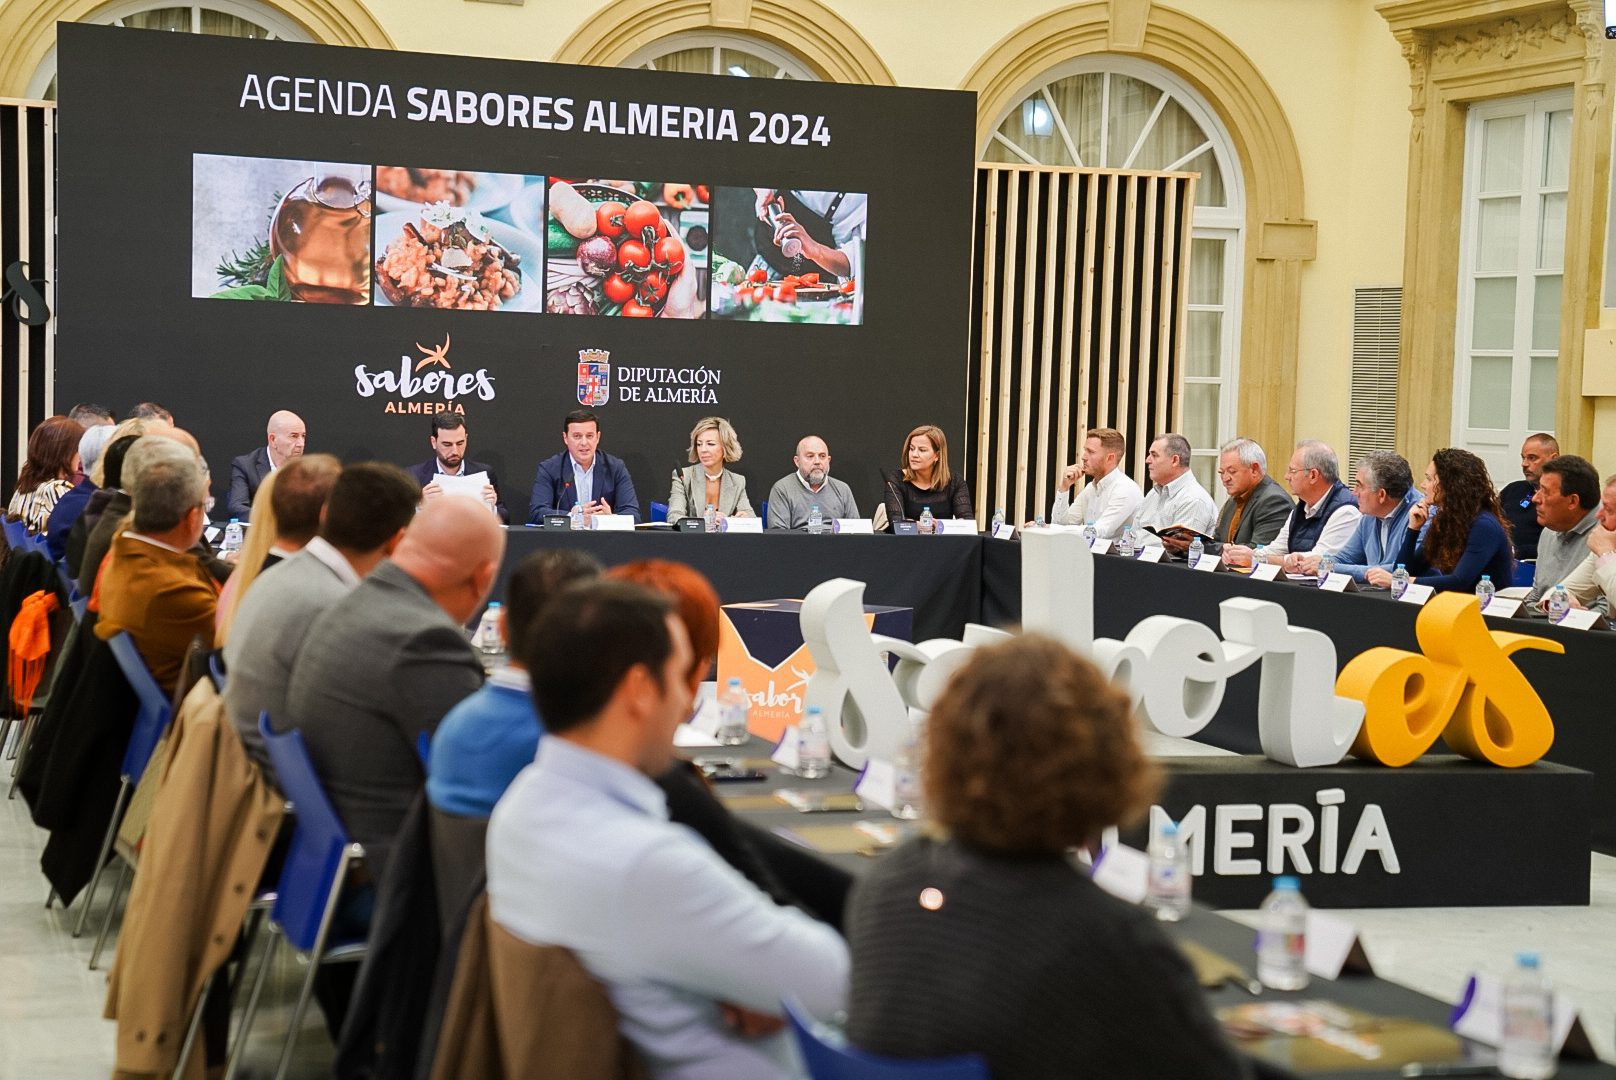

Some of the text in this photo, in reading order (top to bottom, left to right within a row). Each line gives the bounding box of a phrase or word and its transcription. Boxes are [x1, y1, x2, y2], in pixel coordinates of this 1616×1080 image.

[239, 74, 831, 147] AGENDA SABORES ALMERIA 2024
[354, 355, 496, 401] sabores
[617, 366, 721, 385] DIPUTACIÓN
[619, 385, 719, 404] DE ALMERÍA
[752, 709, 791, 719] ALMERÍA
[1066, 788, 1400, 876] MERÍA
